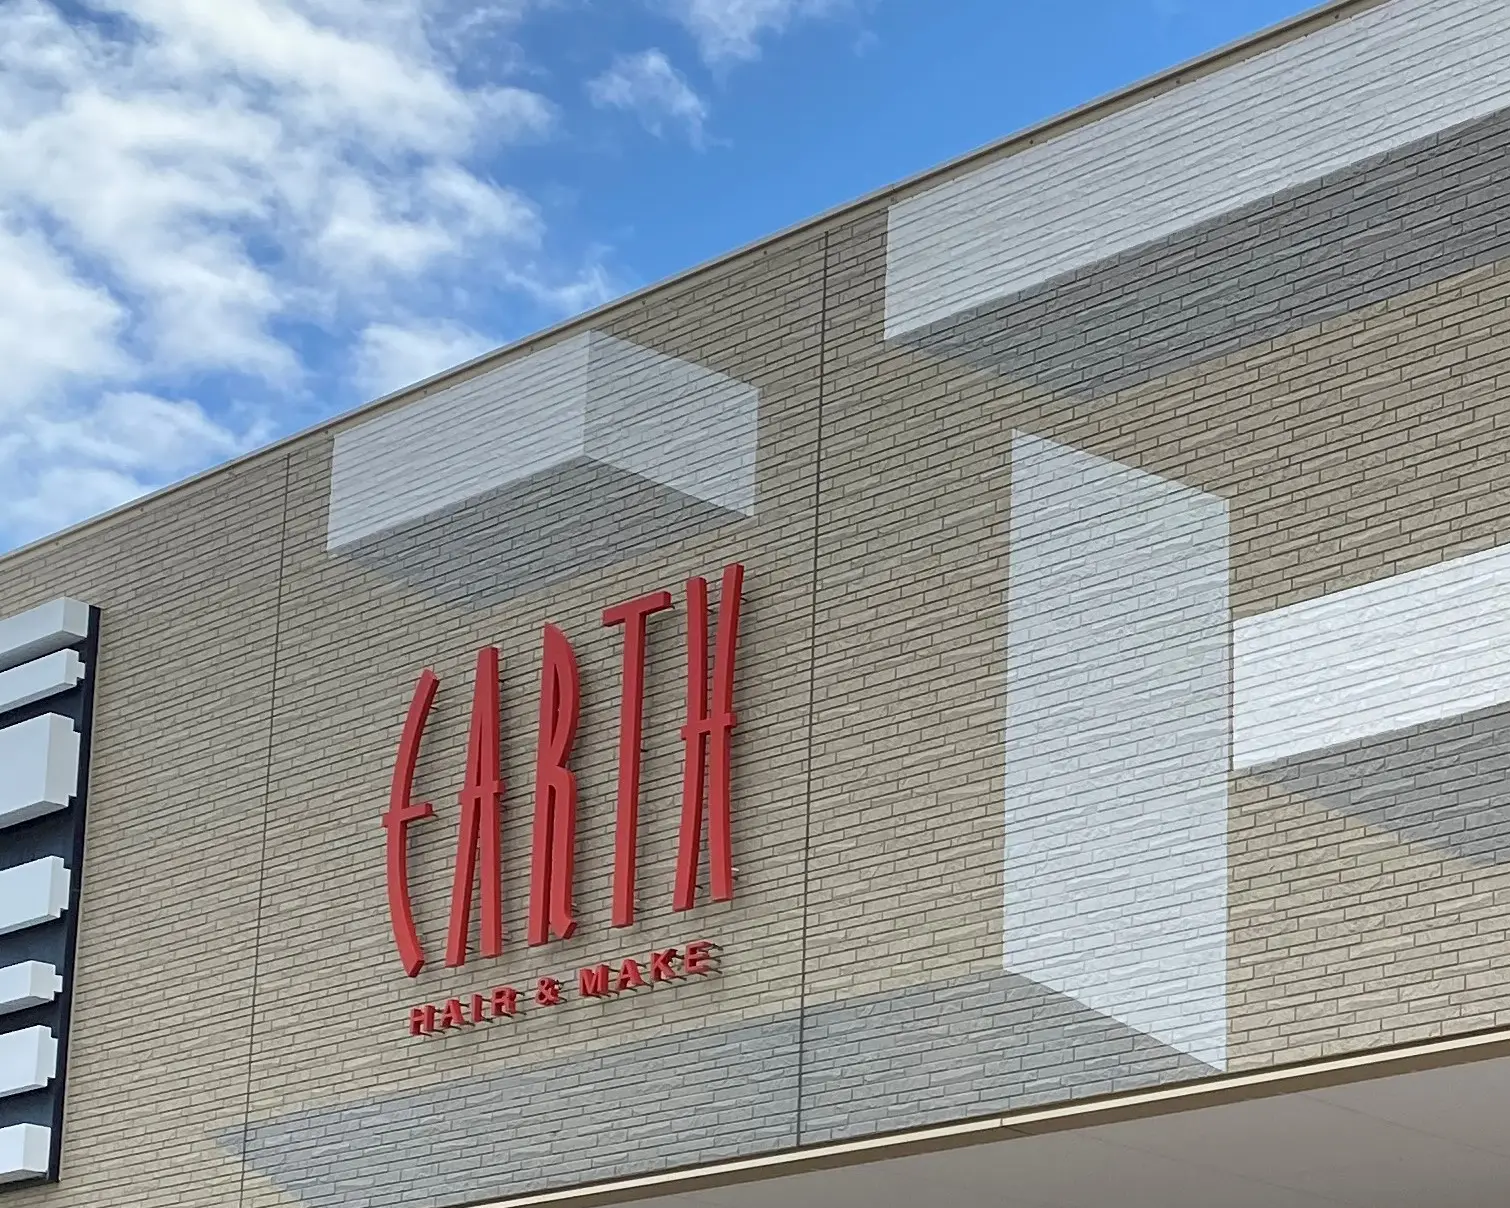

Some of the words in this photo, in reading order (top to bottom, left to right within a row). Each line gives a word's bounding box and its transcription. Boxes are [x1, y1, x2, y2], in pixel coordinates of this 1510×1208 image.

[382, 562, 744, 977] EARTH
[409, 987, 518, 1037] HAIR
[535, 977, 562, 1006] &
[579, 941, 715, 998] MAKE
